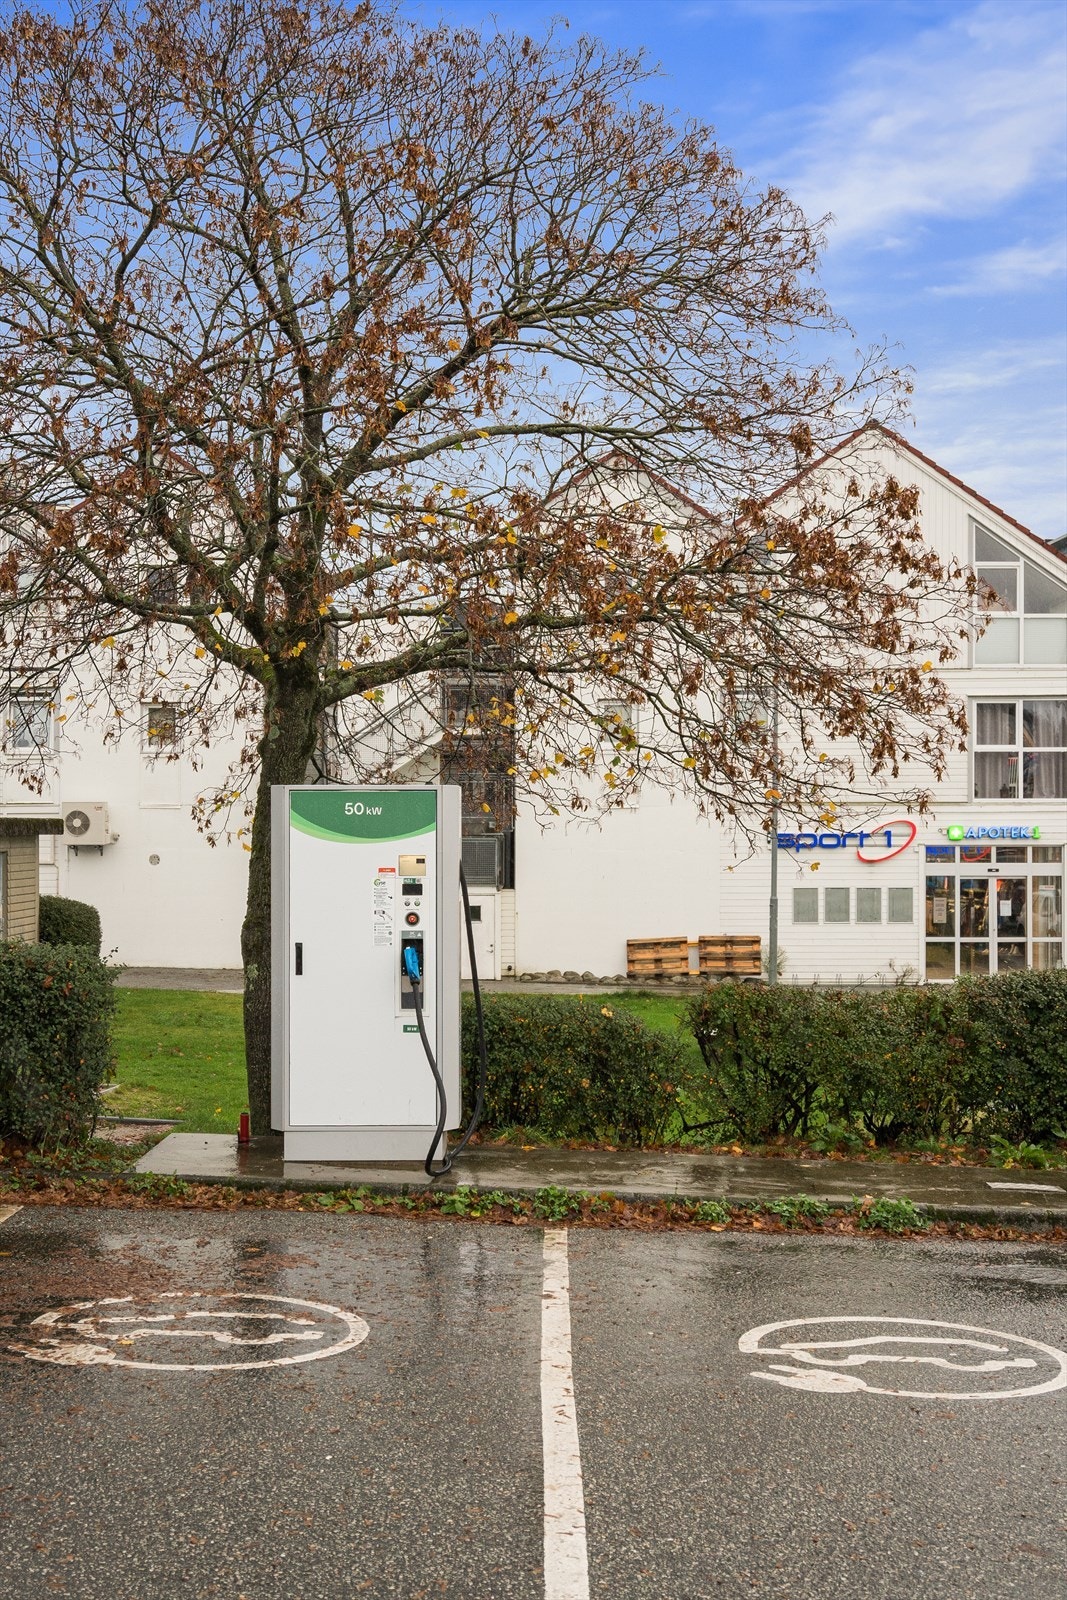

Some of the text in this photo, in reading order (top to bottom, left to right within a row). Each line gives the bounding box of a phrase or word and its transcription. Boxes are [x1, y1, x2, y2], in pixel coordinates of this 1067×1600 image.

[344, 802, 382, 815] 50 kW
[966, 825, 1041, 839] APOTEK 1
[777, 830, 892, 853] sport 1
